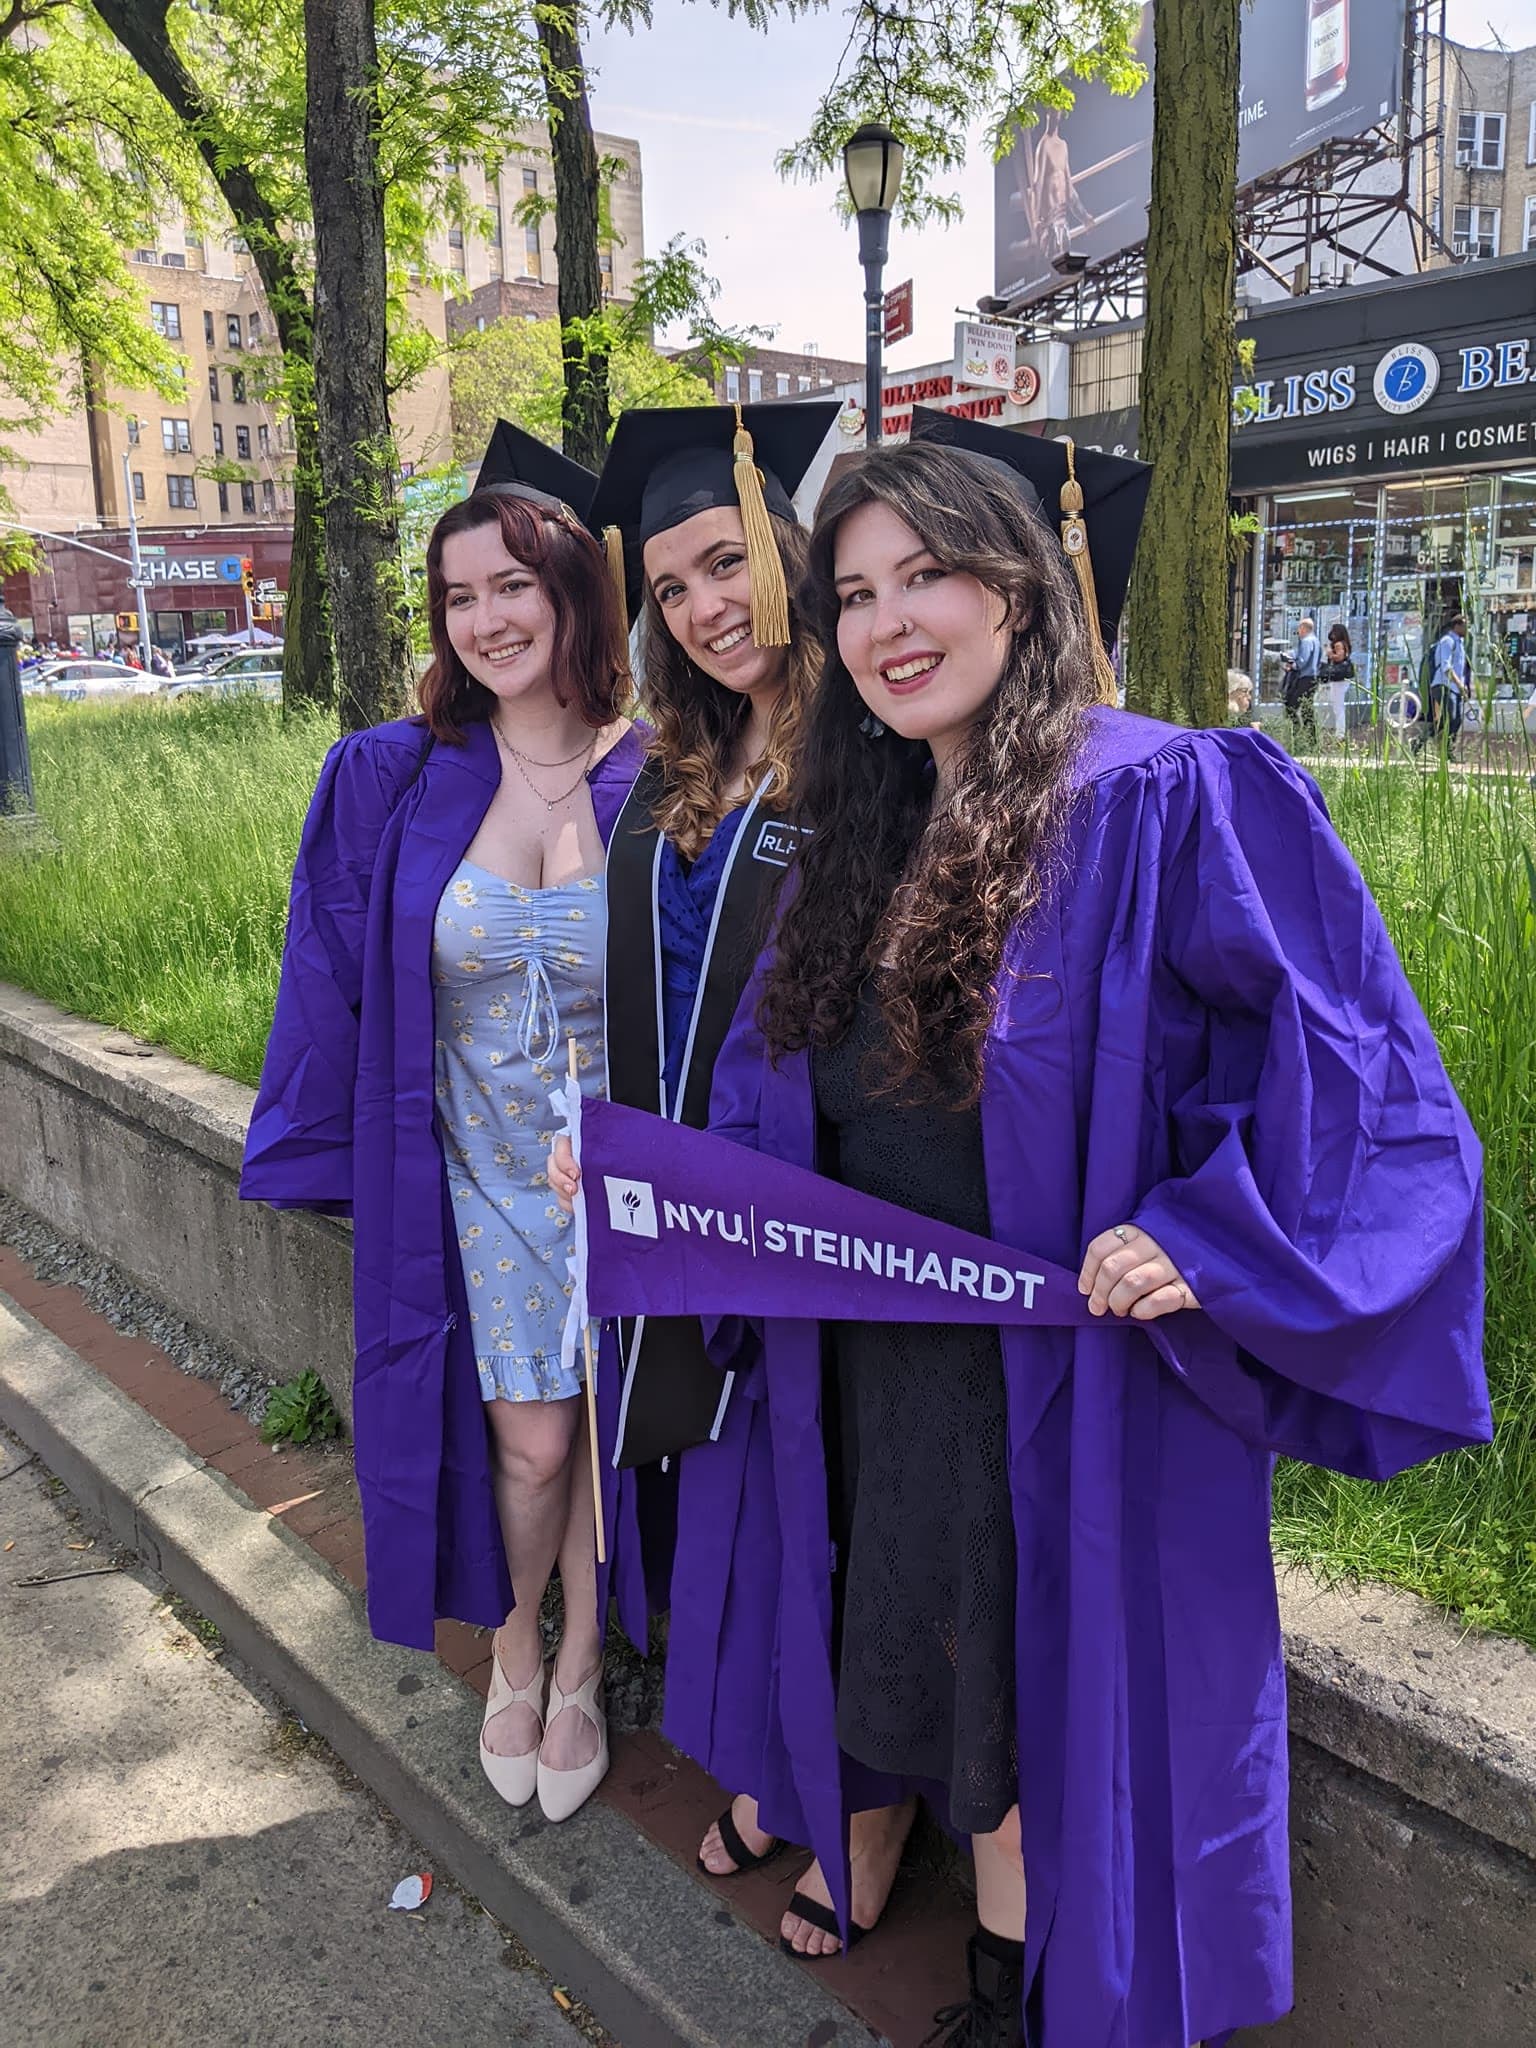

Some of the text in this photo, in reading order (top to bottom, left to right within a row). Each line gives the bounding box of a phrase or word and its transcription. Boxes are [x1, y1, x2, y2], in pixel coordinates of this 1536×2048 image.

[1239, 99, 1268, 129] TIME.
[967, 326, 1013, 342] BULLPEN DELI
[967, 336, 1013, 352] TWIN DONUT
[1391, 346, 1424, 360] BLISS
[1456, 338, 1536, 392] BE
[880, 375, 953, 407] ULLPEN
[1377, 384, 1432, 411] BEAUTY SUPPLY
[944, 395, 1006, 420] ONUT
[1307, 443, 1357, 468] WIGS
[1383, 435, 1430, 459] HAIR
[764, 1219, 1045, 1310] STEINHARDT
